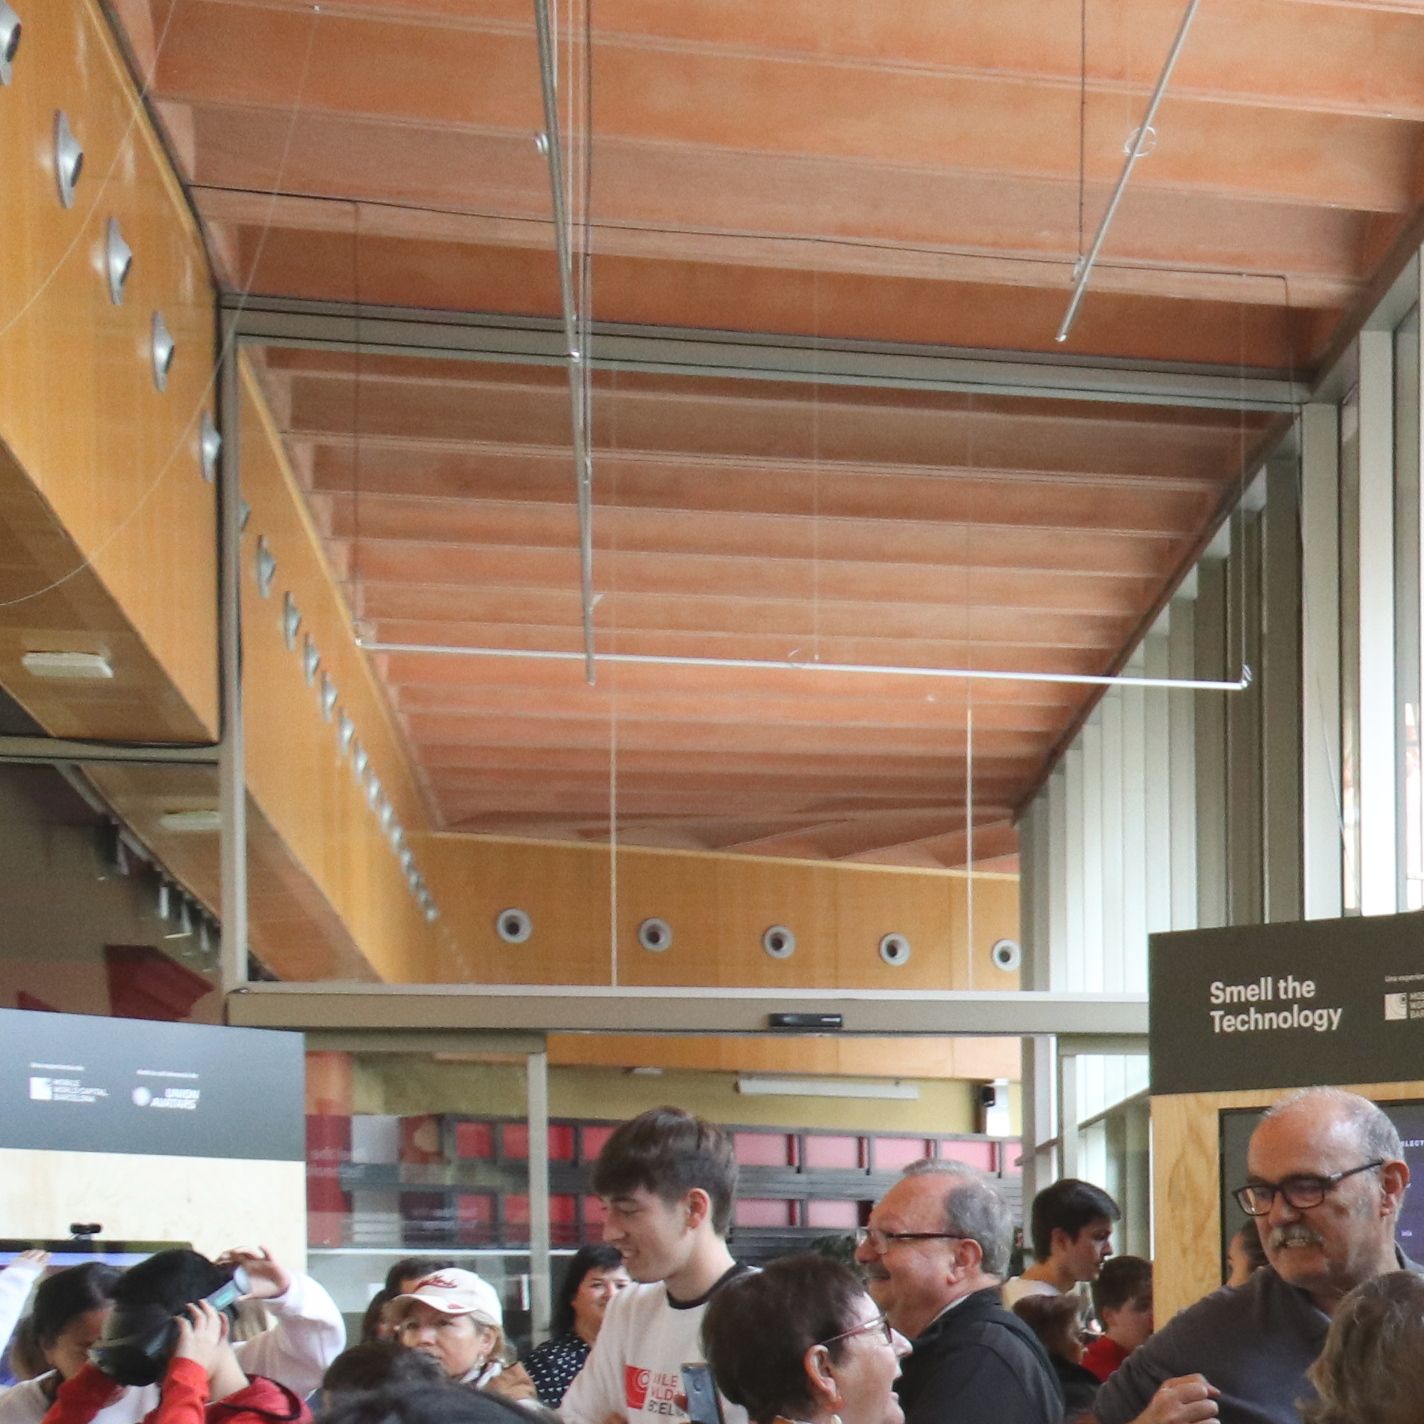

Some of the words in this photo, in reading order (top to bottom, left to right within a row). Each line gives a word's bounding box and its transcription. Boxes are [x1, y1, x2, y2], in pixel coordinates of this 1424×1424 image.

[1210, 976, 1273, 1005] Smell
[1277, 975, 1316, 1000] the
[1210, 1005, 1343, 1034] Technology
